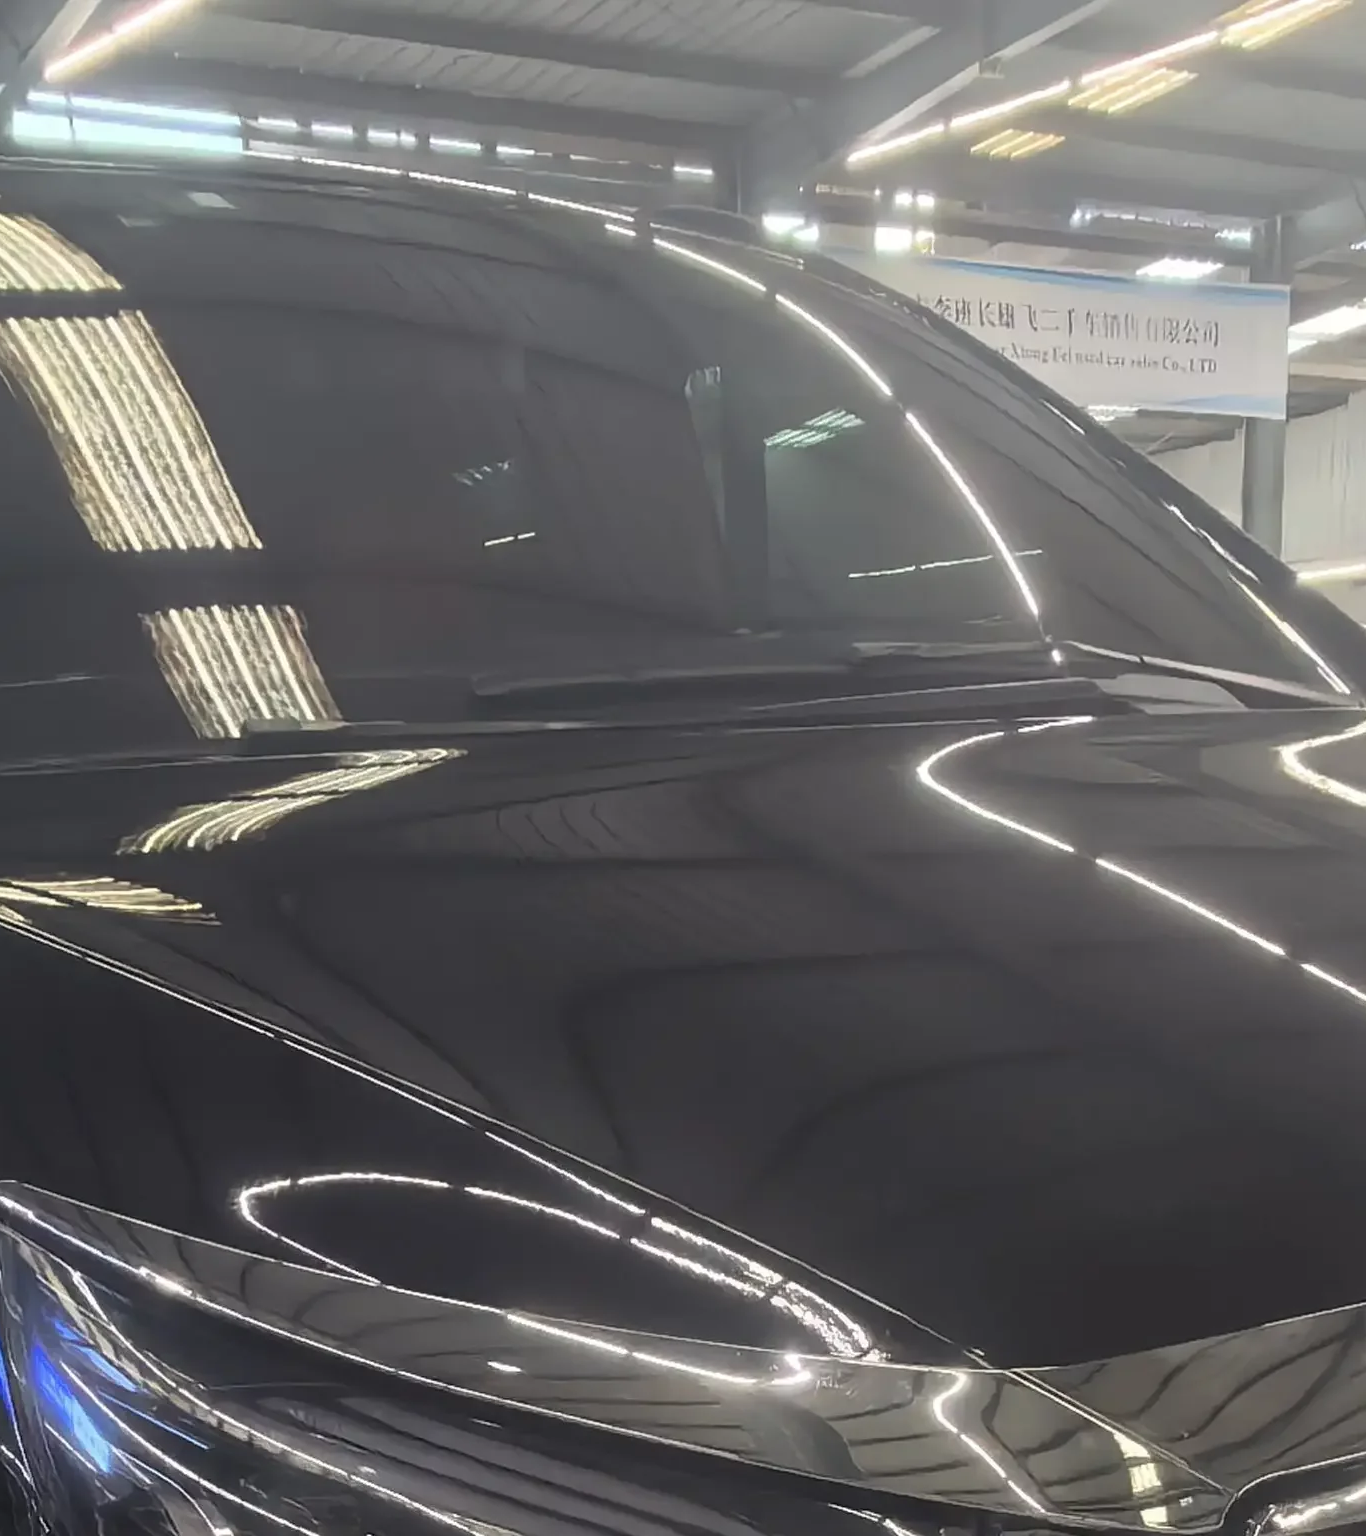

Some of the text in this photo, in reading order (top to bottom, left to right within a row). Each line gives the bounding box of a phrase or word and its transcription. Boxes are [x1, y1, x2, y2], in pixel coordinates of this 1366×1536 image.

[916, 293, 1220, 348] 李班长雄飞二手车销售有限公司
